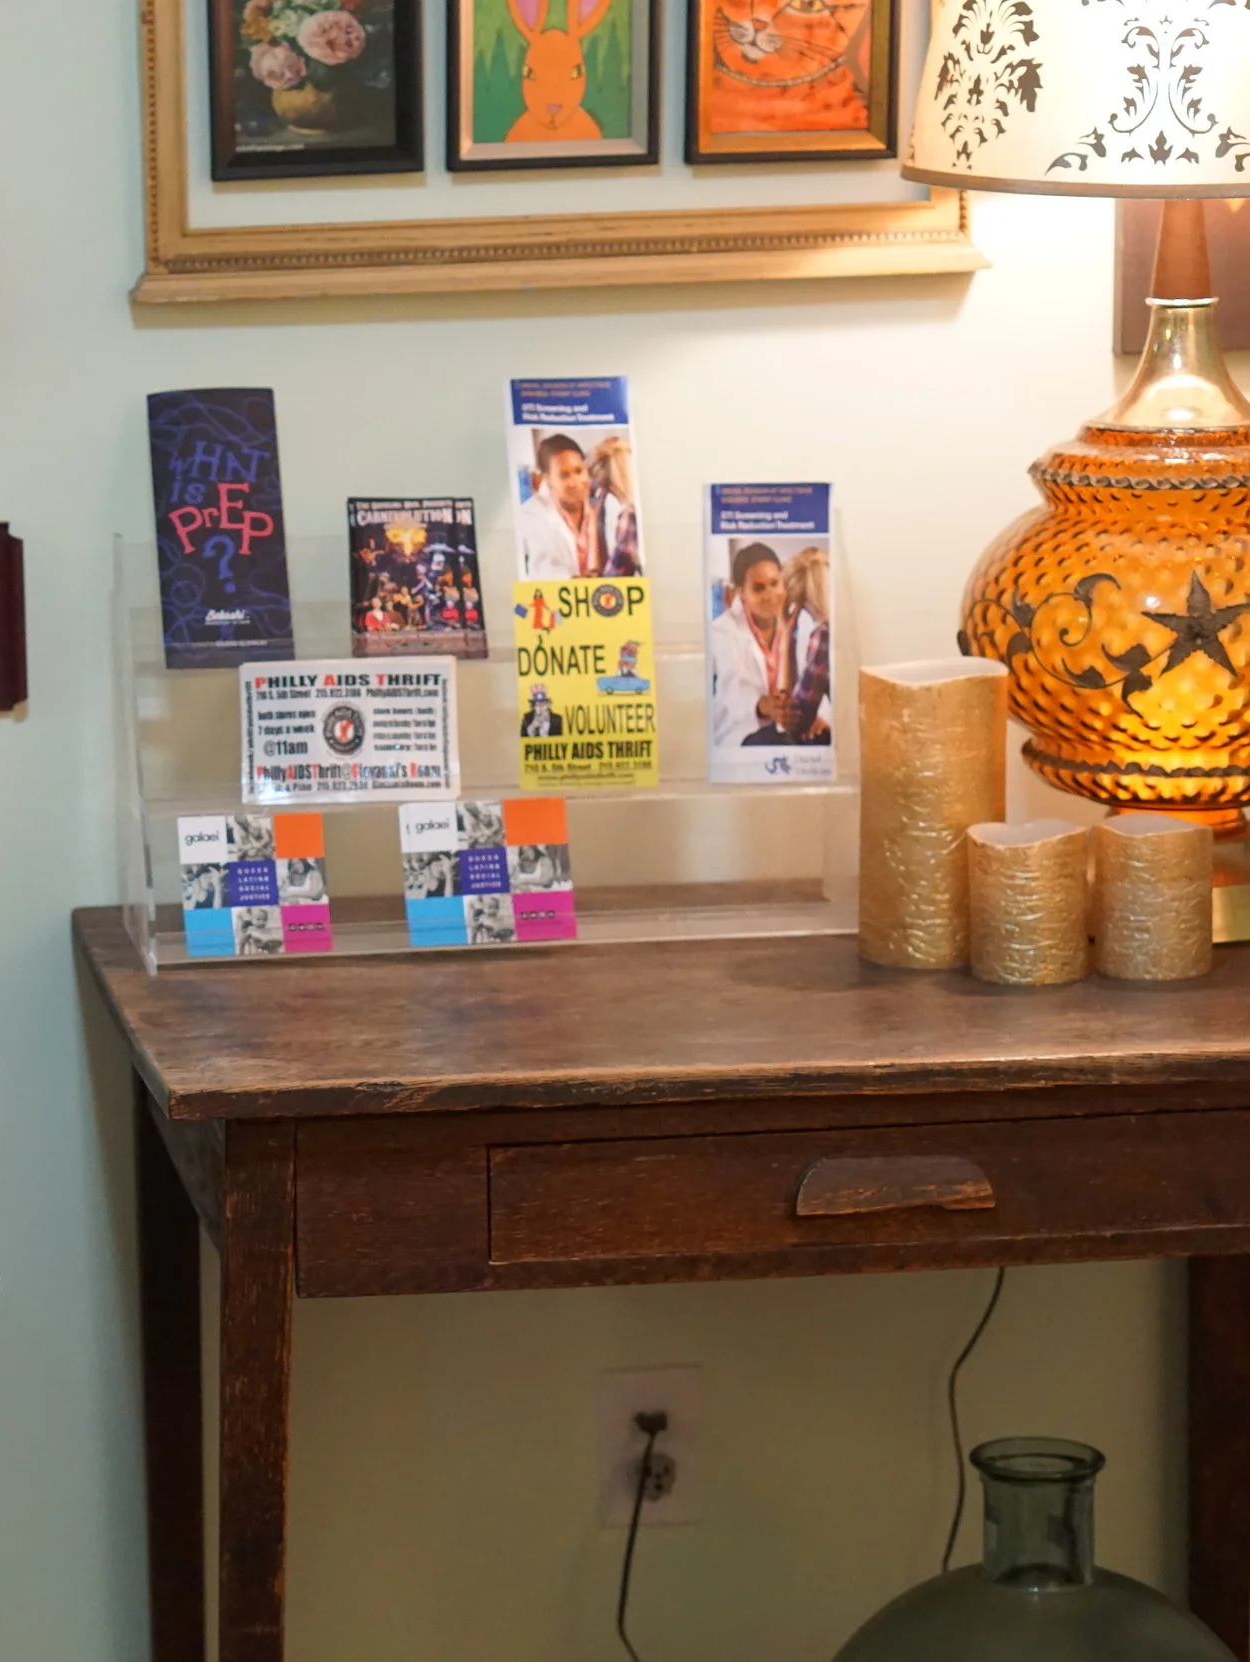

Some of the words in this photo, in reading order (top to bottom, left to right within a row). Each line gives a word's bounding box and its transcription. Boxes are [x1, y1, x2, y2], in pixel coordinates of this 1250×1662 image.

[167, 482, 275, 556] PrEP
[558, 584, 645, 618] SHOP
[517, 644, 607, 678] DONATE
[255, 674, 319, 690] PHILLY
[324, 673, 370, 687] AIDS
[376, 673, 441, 686] THRIFT
[564, 703, 657, 736] VOLUNTEER
[525, 742, 568, 761] PHILLY
[571, 741, 604, 759] AIDS
[607, 739, 652, 759] THRIFT
